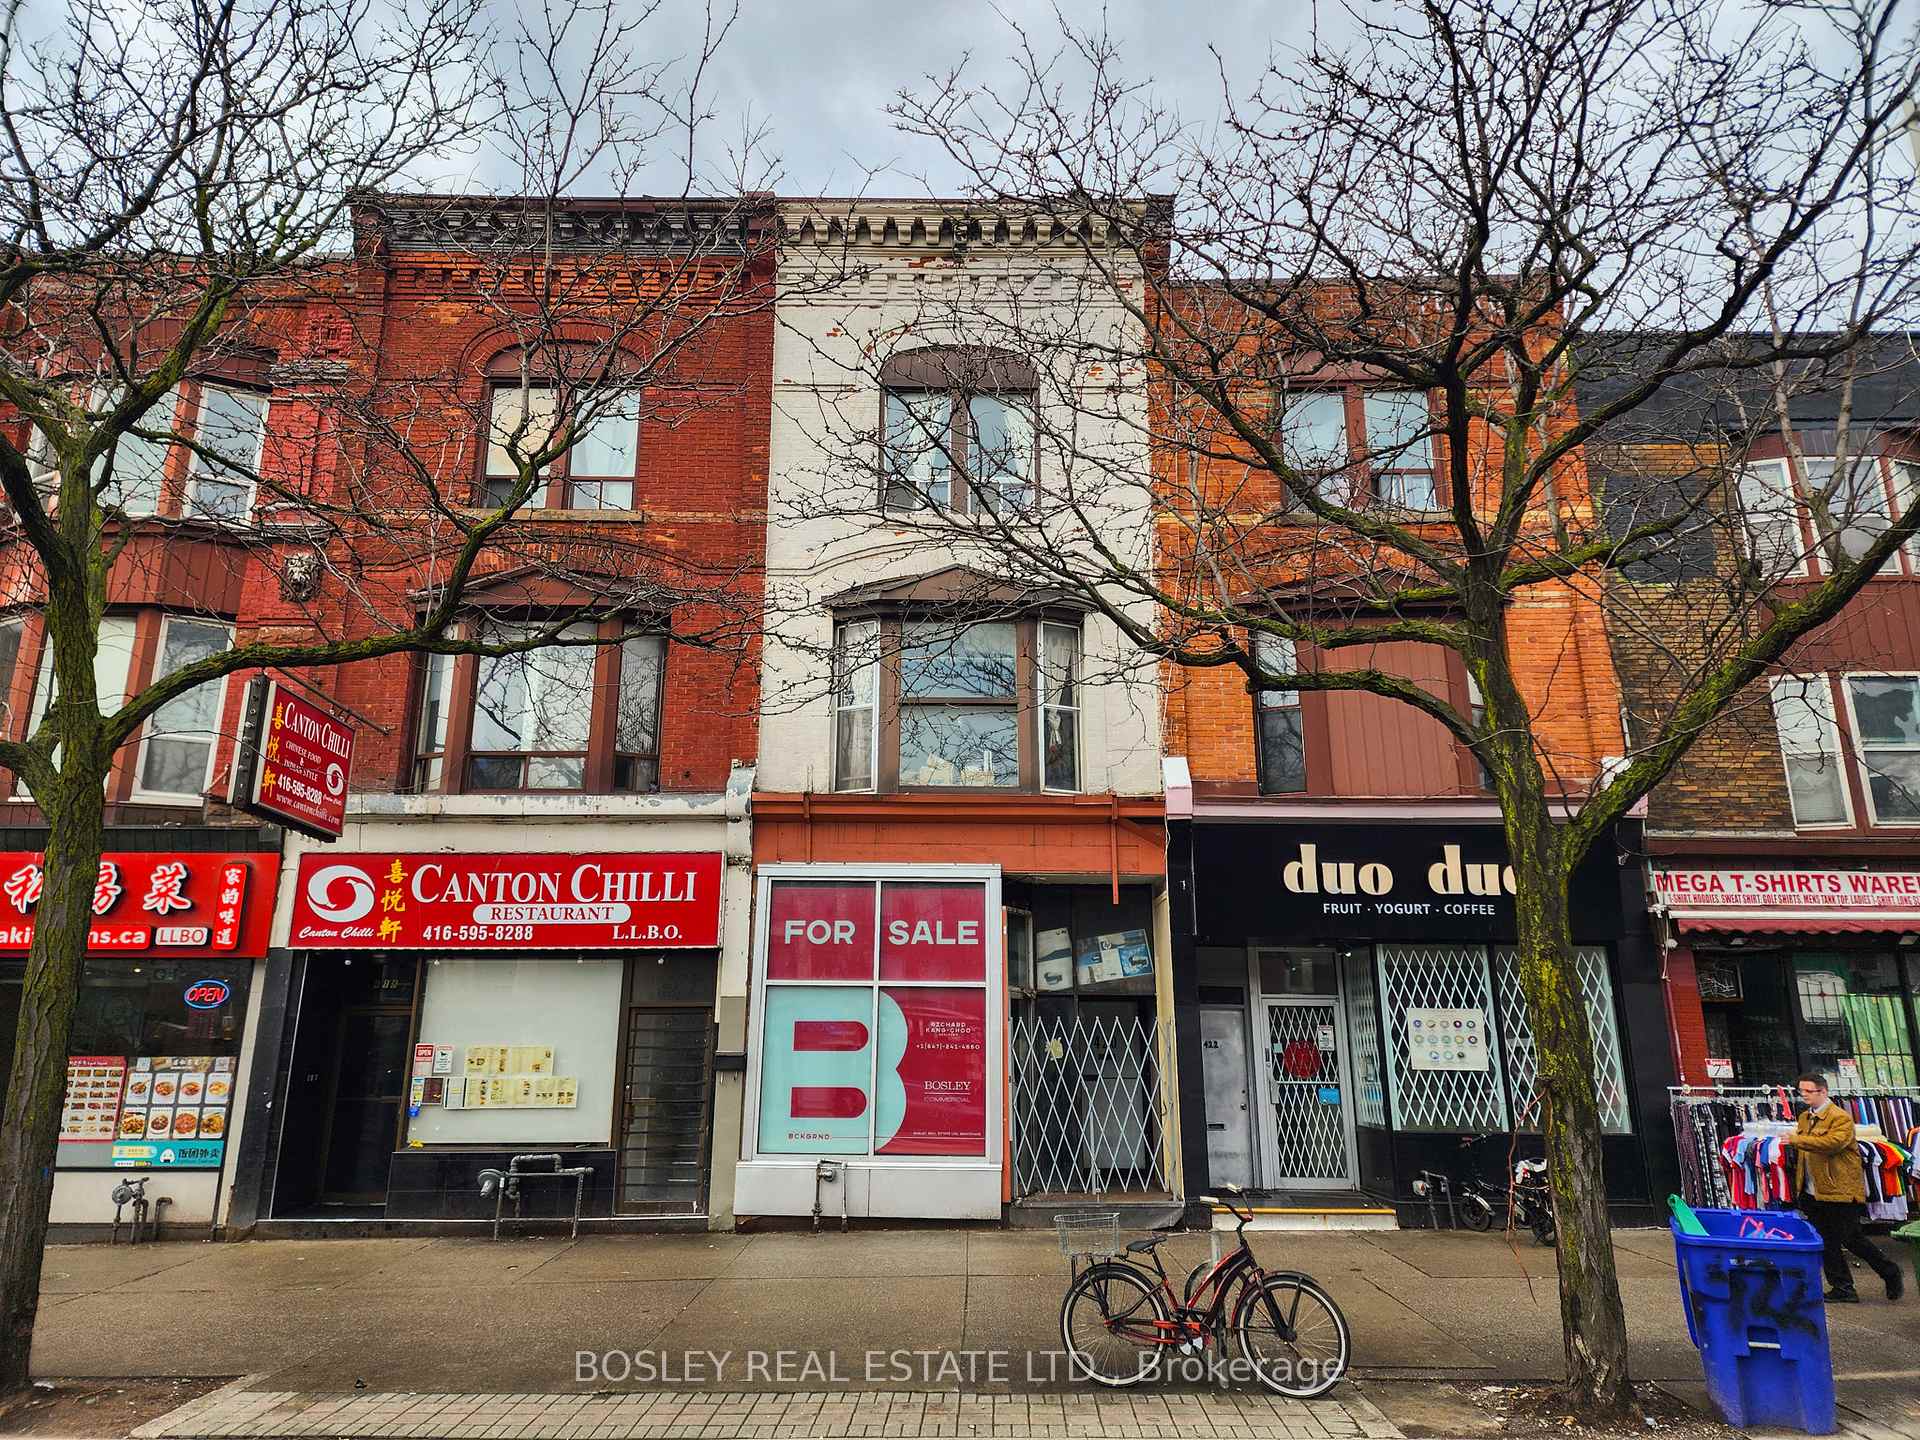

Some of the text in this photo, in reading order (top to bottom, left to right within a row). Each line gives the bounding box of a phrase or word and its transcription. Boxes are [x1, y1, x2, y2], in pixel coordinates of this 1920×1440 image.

[284, 702, 351, 759] CANTON CHILLI
[277, 773, 323, 805] 416-595-8288
[1283, 843, 1394, 896] duo
[411, 863, 698, 904] CANTON CHILLI
[1655, 874, 1920, 894] MEGA T-SHIRTS WARE
[489, 905, 615, 922] RESTAURANT
[1323, 902, 1496, 915] FRUIT YOGURT COFFEE
[159, 929, 205, 944] LLBO
[298, 926, 375, 938] Canton Chilli
[422, 923, 683, 942] 416-595-8288 L.L.B.O.
[783, 919, 980, 946] FOR SALE
[186, 987, 225, 1003] OPEN
[924, 1080, 972, 1091] BOSLEY
